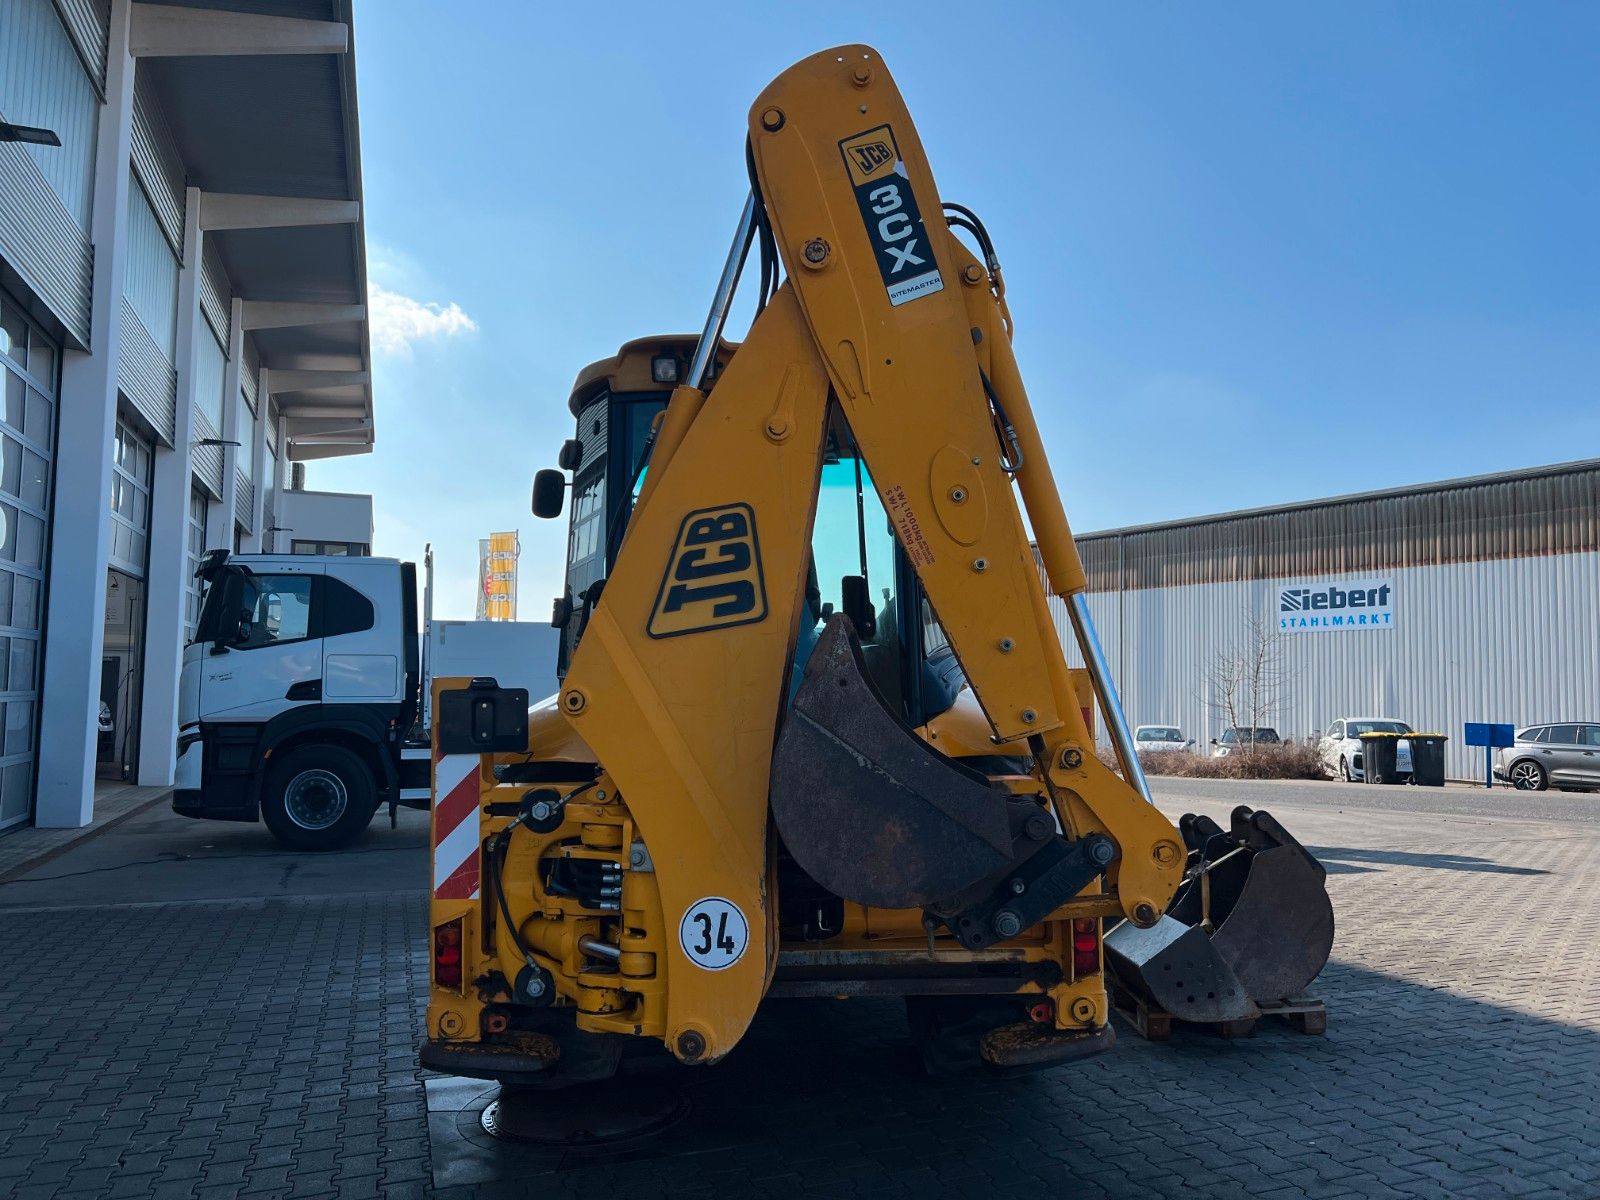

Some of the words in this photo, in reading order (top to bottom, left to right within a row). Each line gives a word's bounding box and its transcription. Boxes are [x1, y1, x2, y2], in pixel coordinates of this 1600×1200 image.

[856, 143, 890, 171] JCB
[869, 184, 926, 274] 3CX
[890, 278, 940, 298] SITEMASTER
[886, 490, 899, 511] SWL
[894, 486, 907, 507] SWL
[904, 508, 922, 541] 1000kg
[663, 512, 756, 618] JCB
[1280, 583, 1391, 612] Siebert
[1280, 613, 1391, 628] STAHLMARKT
[693, 912, 735, 955] 34
